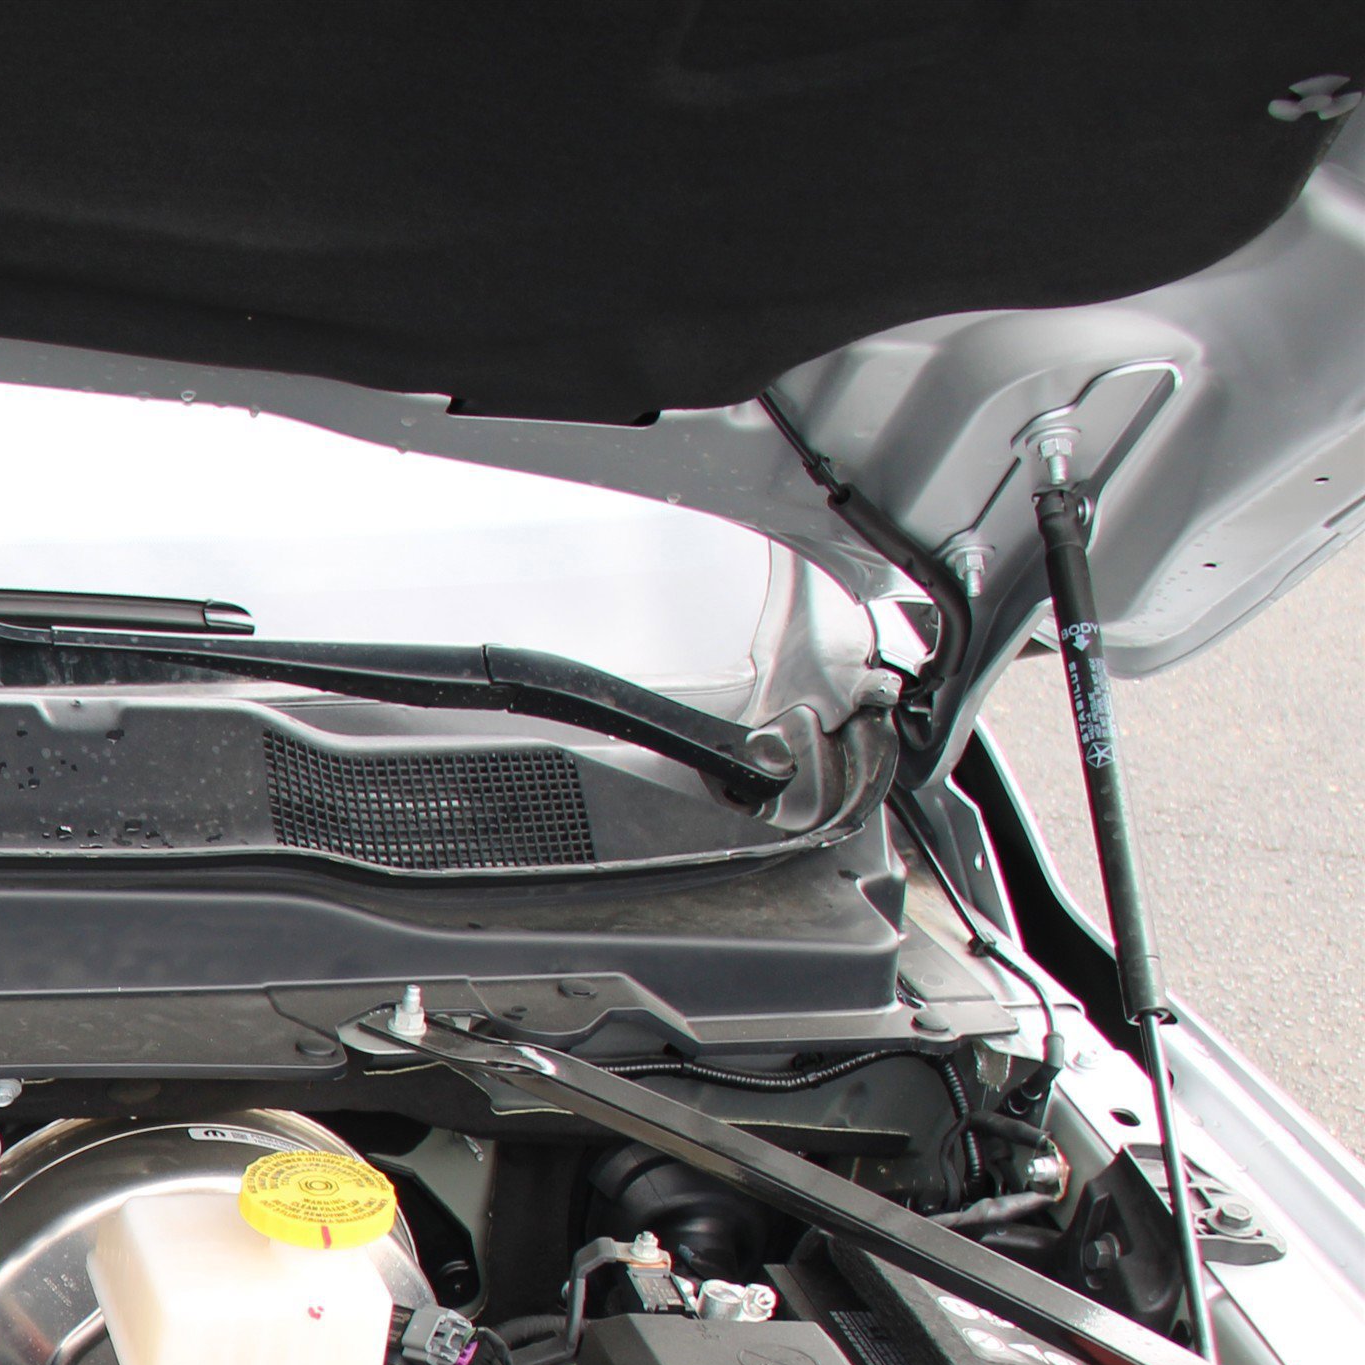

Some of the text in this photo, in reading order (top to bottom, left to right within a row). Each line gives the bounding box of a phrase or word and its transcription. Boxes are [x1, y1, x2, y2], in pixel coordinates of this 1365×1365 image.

[1061, 622, 1098, 641] BODY
[1068, 661, 1089, 744] STABILUS
[304, 1198, 346, 1207] WARNING
